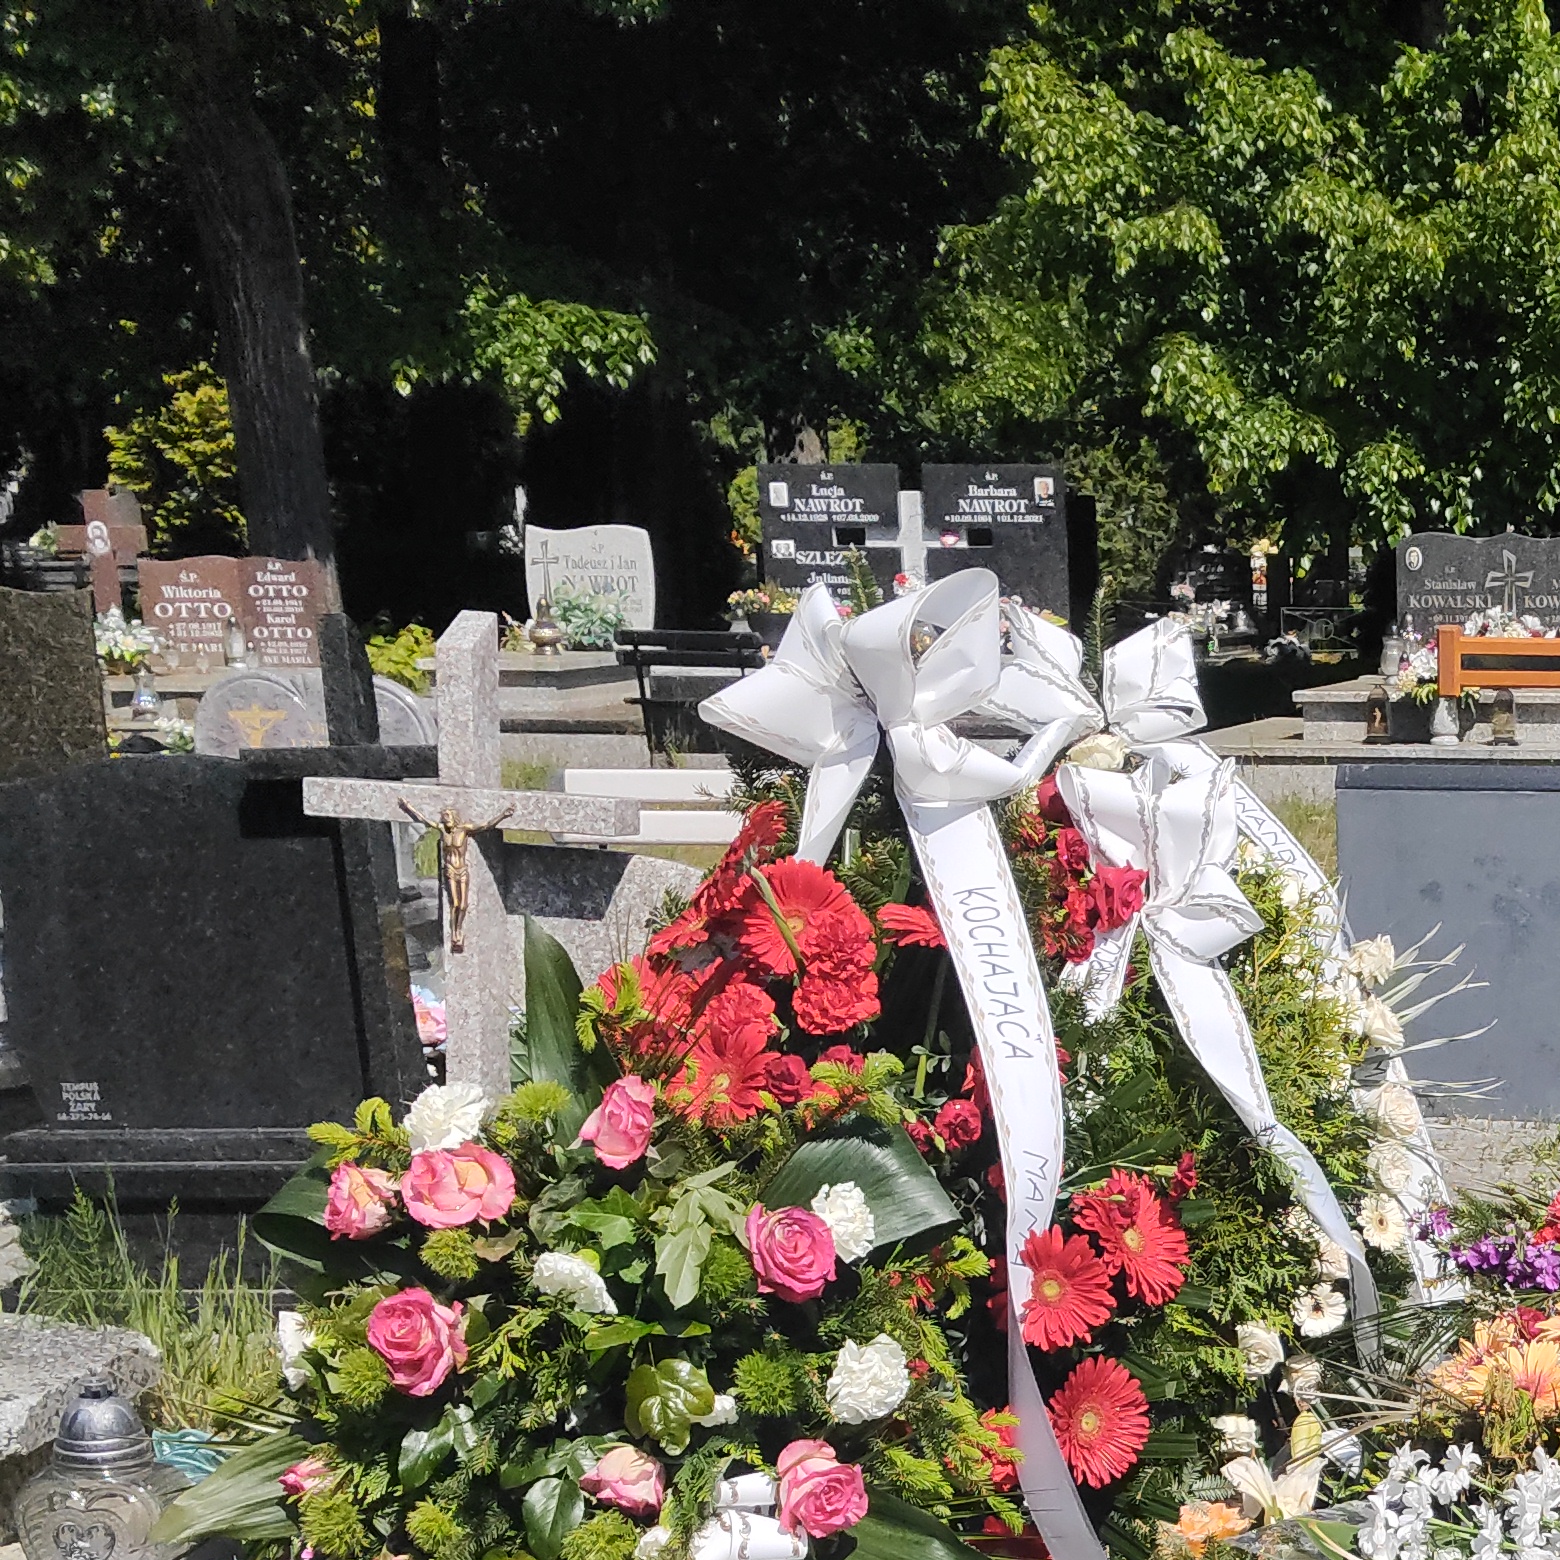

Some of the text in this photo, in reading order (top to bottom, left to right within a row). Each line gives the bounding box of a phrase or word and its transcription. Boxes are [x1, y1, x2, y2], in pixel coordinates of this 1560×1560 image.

[968, 485, 1017, 496] Barbara
[794, 498, 864, 512] NAWROT
[958, 499, 1028, 512] NAWROT
[563, 555, 608, 570] Tadeusz
[618, 555, 637, 570] Jan
[256, 572, 296, 582] Edward
[160, 586, 221, 598] Wiktoria
[248, 585, 309, 597] OTTO
[1409, 594, 1492, 608] KOWALSKI
[154, 602, 232, 618] OTTO
[267, 614, 296, 624] Karol
[253, 626, 312, 638] OTTO
